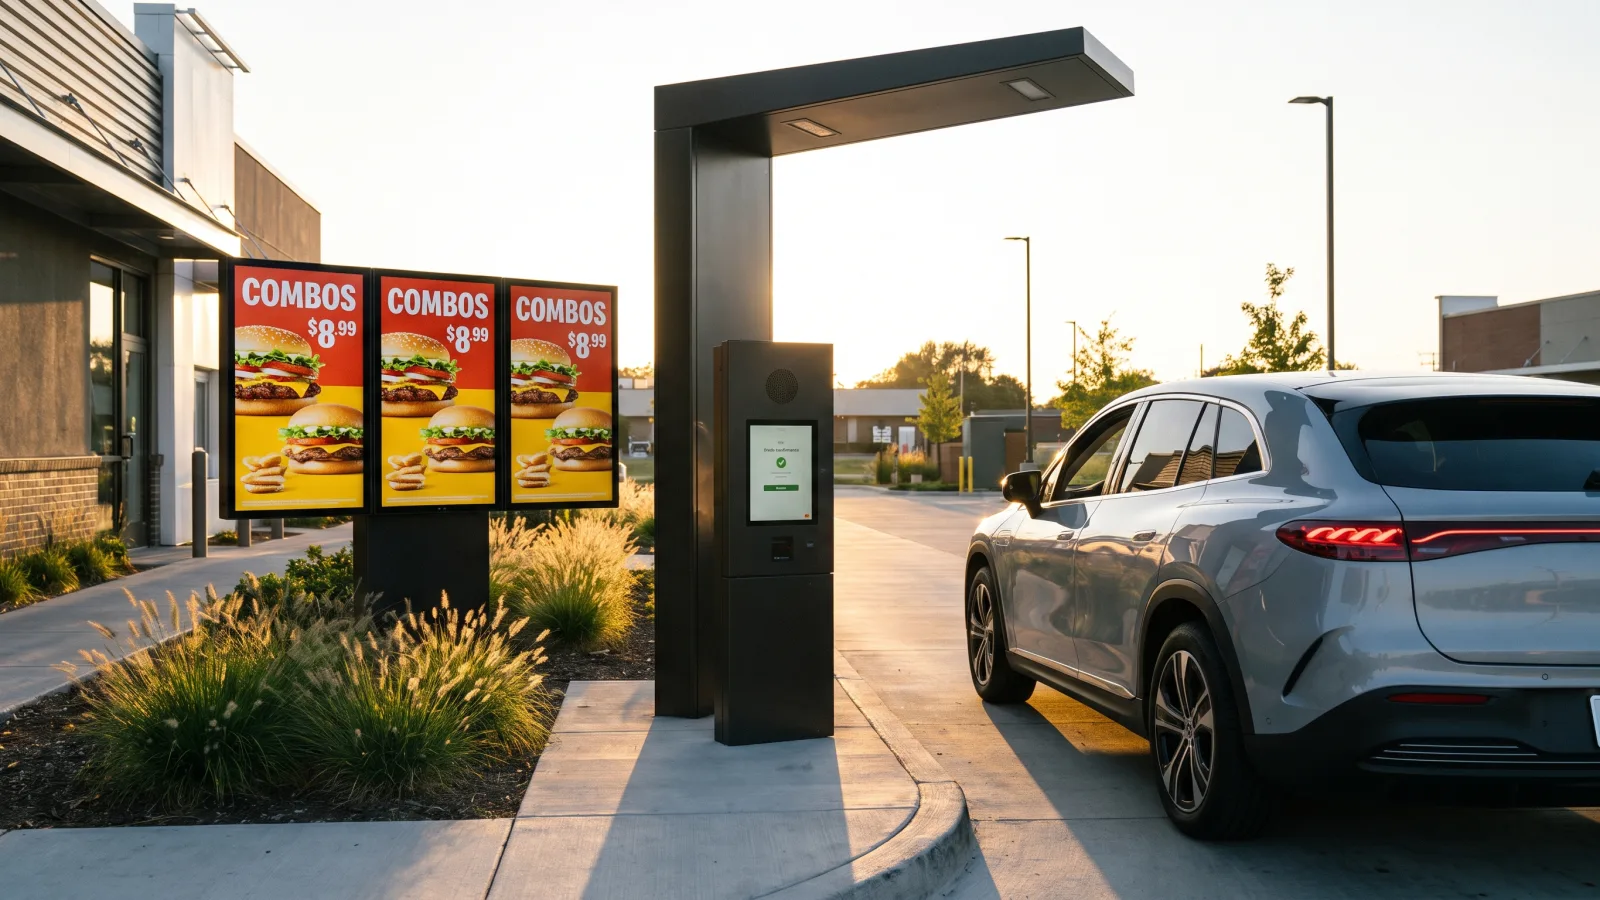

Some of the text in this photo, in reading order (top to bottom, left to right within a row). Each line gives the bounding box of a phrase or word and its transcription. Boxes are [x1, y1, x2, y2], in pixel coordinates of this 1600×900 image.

[242, 277, 356, 312] COMBOS
[387, 287, 489, 320] COMBOS
[516, 295, 607, 326] COMBOS
[307, 317, 357, 349] $8.99
[446, 324, 489, 354] $8.99
[568, 330, 607, 359] $8.99
